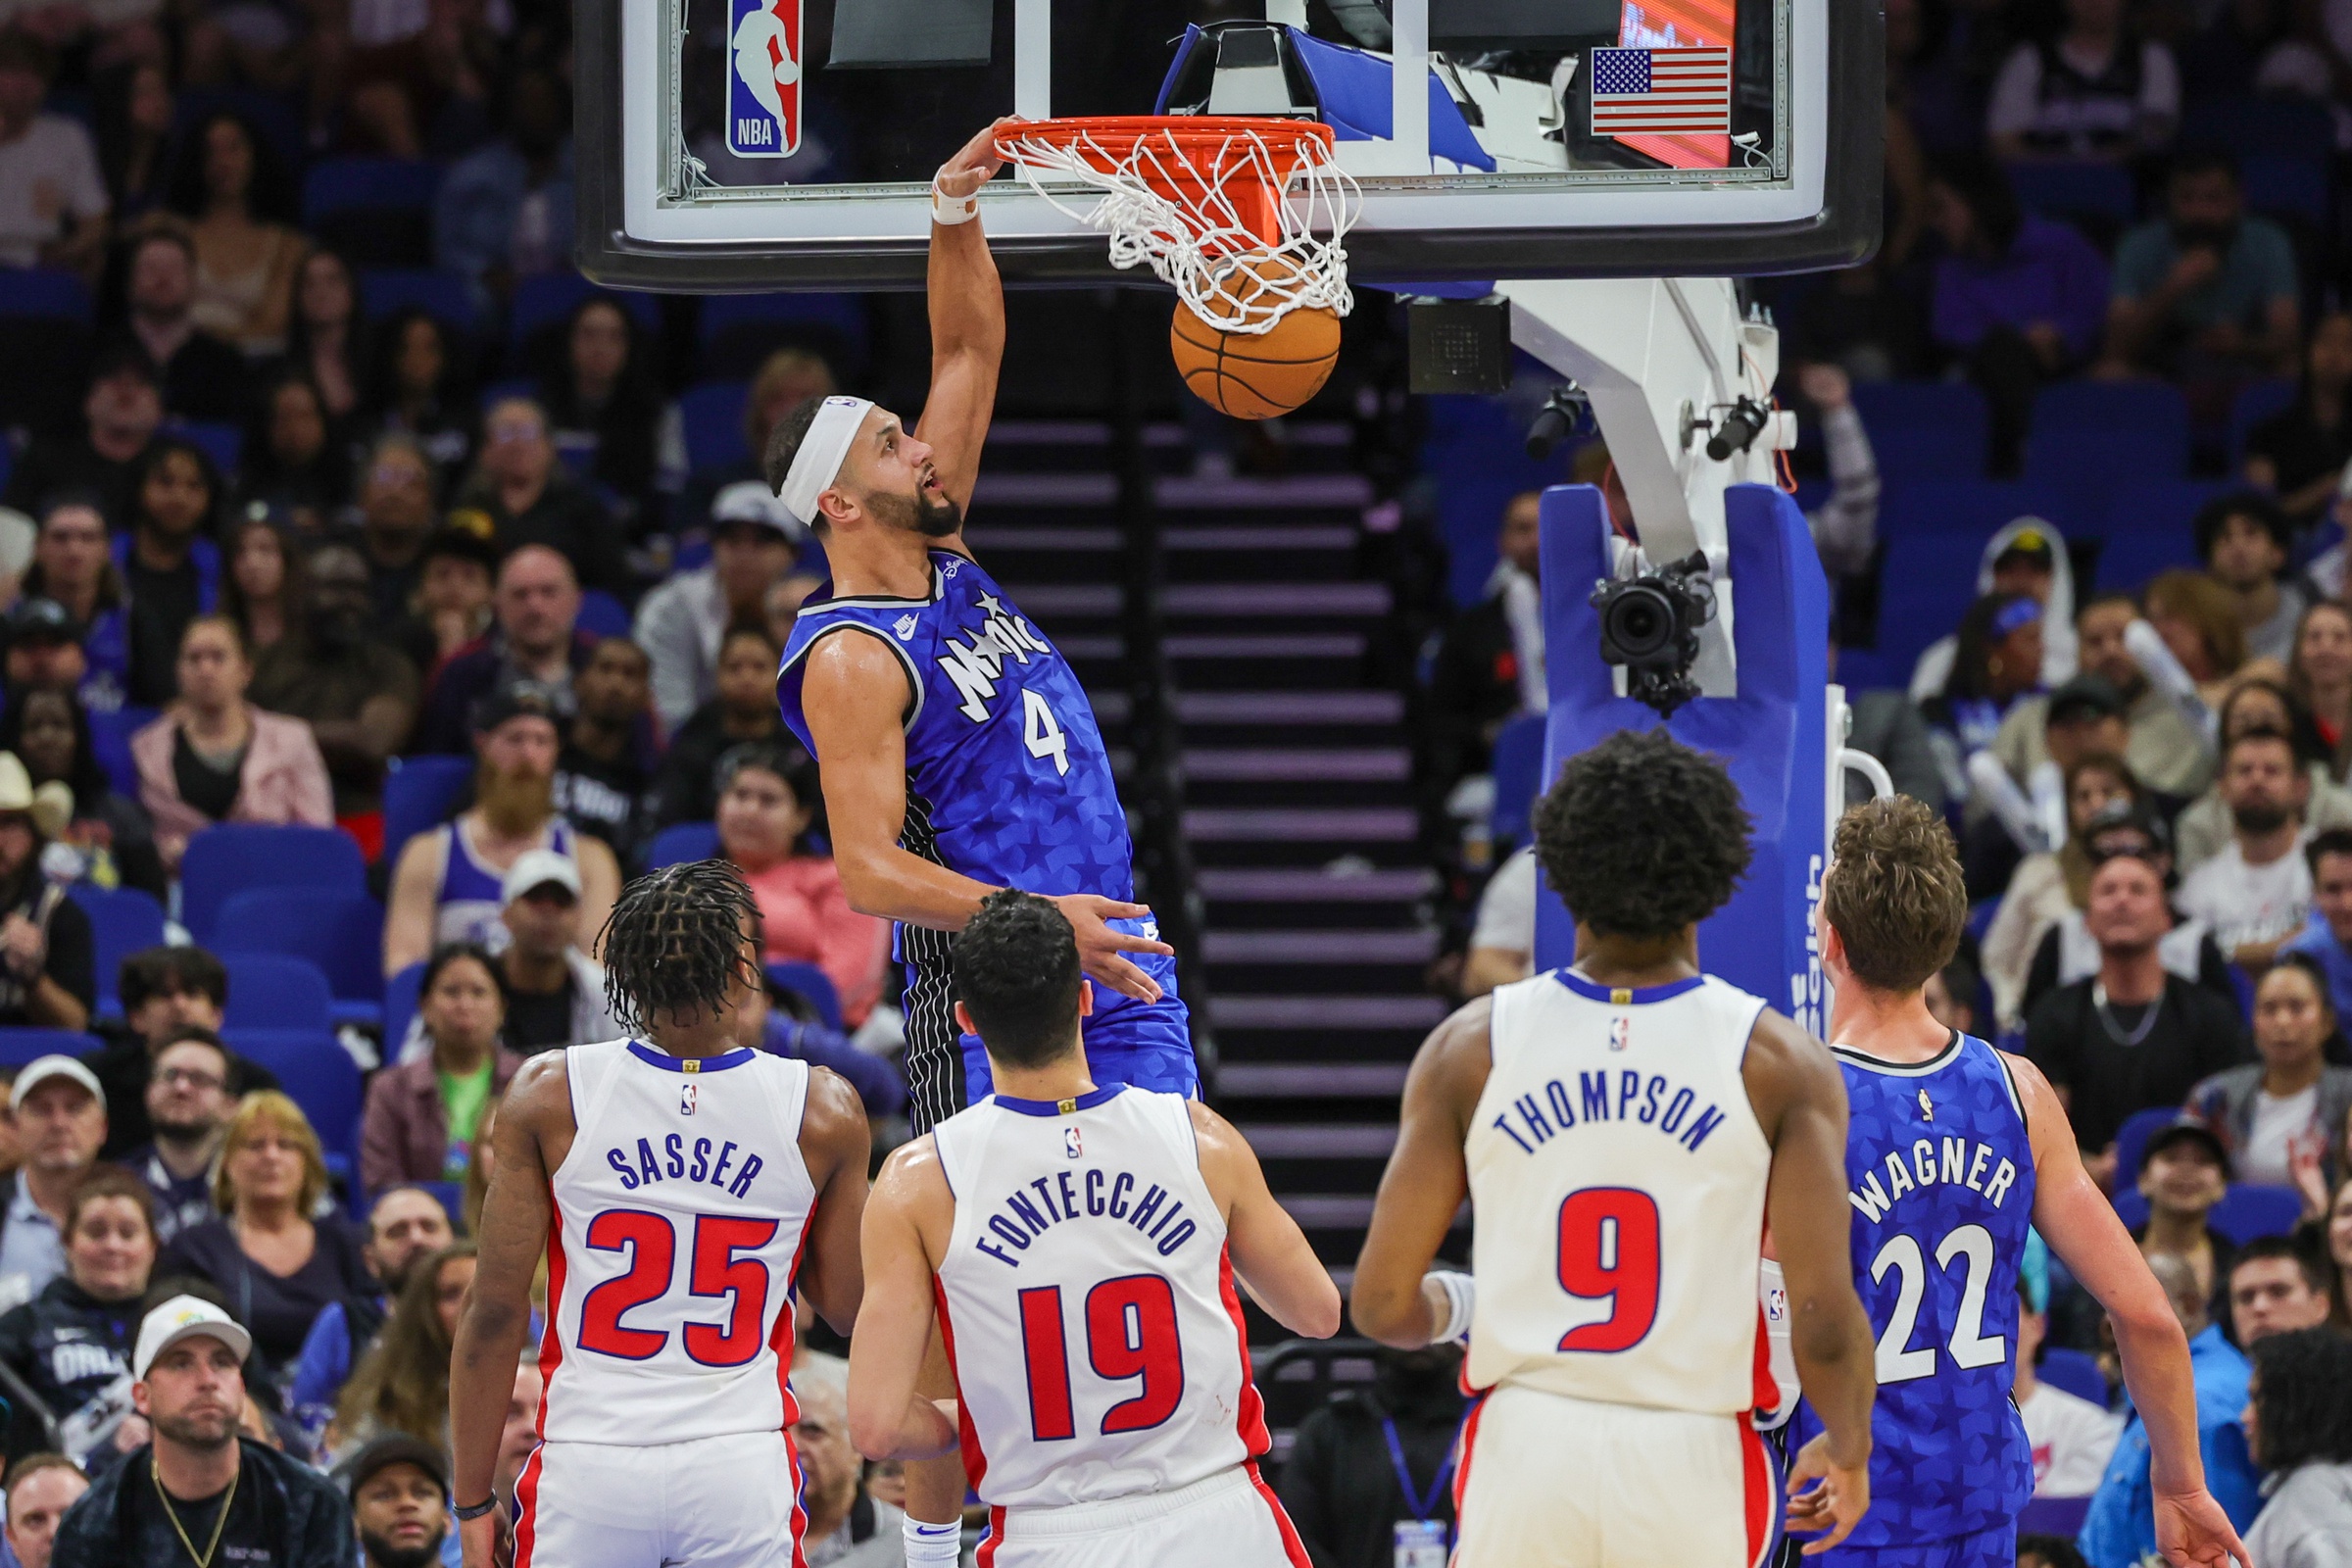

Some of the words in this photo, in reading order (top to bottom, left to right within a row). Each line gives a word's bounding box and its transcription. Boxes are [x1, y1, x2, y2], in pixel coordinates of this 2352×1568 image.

[738, 119, 772, 146] NBA
[892, 613, 912, 634] NIKE
[1021, 687, 1070, 777] 4
[1493, 1070, 1727, 1155] THOMPSON
[607, 1133, 763, 1200] SASSER
[1847, 1137, 2016, 1225] WAGNER
[975, 1169, 1197, 1268] FONTECCHIO
[576, 1208, 780, 1368] 25
[1556, 1186, 1660, 1353] 9
[1870, 1224, 2006, 1385] 22
[1017, 1273, 1185, 1442] 19
